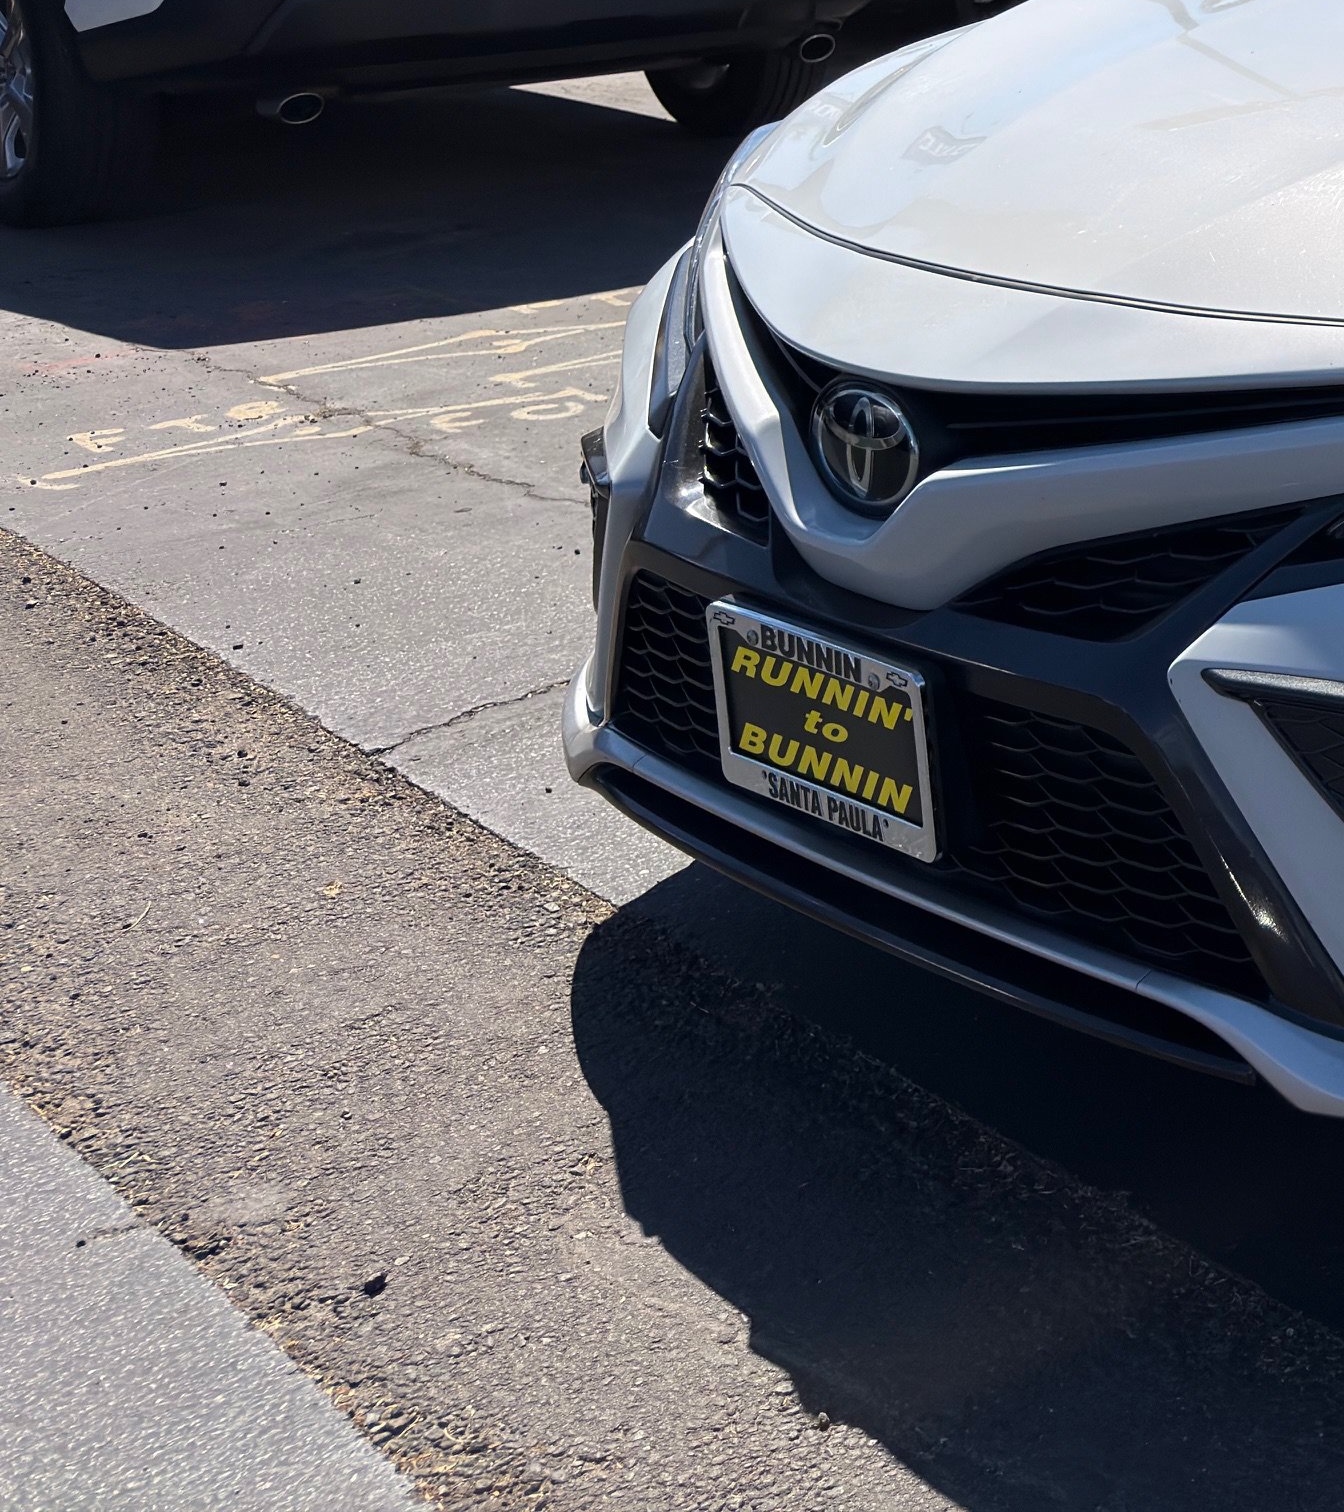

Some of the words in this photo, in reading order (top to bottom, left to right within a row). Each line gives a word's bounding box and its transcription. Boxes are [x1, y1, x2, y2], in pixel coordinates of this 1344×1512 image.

[731, 646, 914, 731] RUNNIN'
[761, 624, 863, 684] BUNNIN
[804, 709, 849, 744] to
[738, 722, 914, 815] BUNNIN
